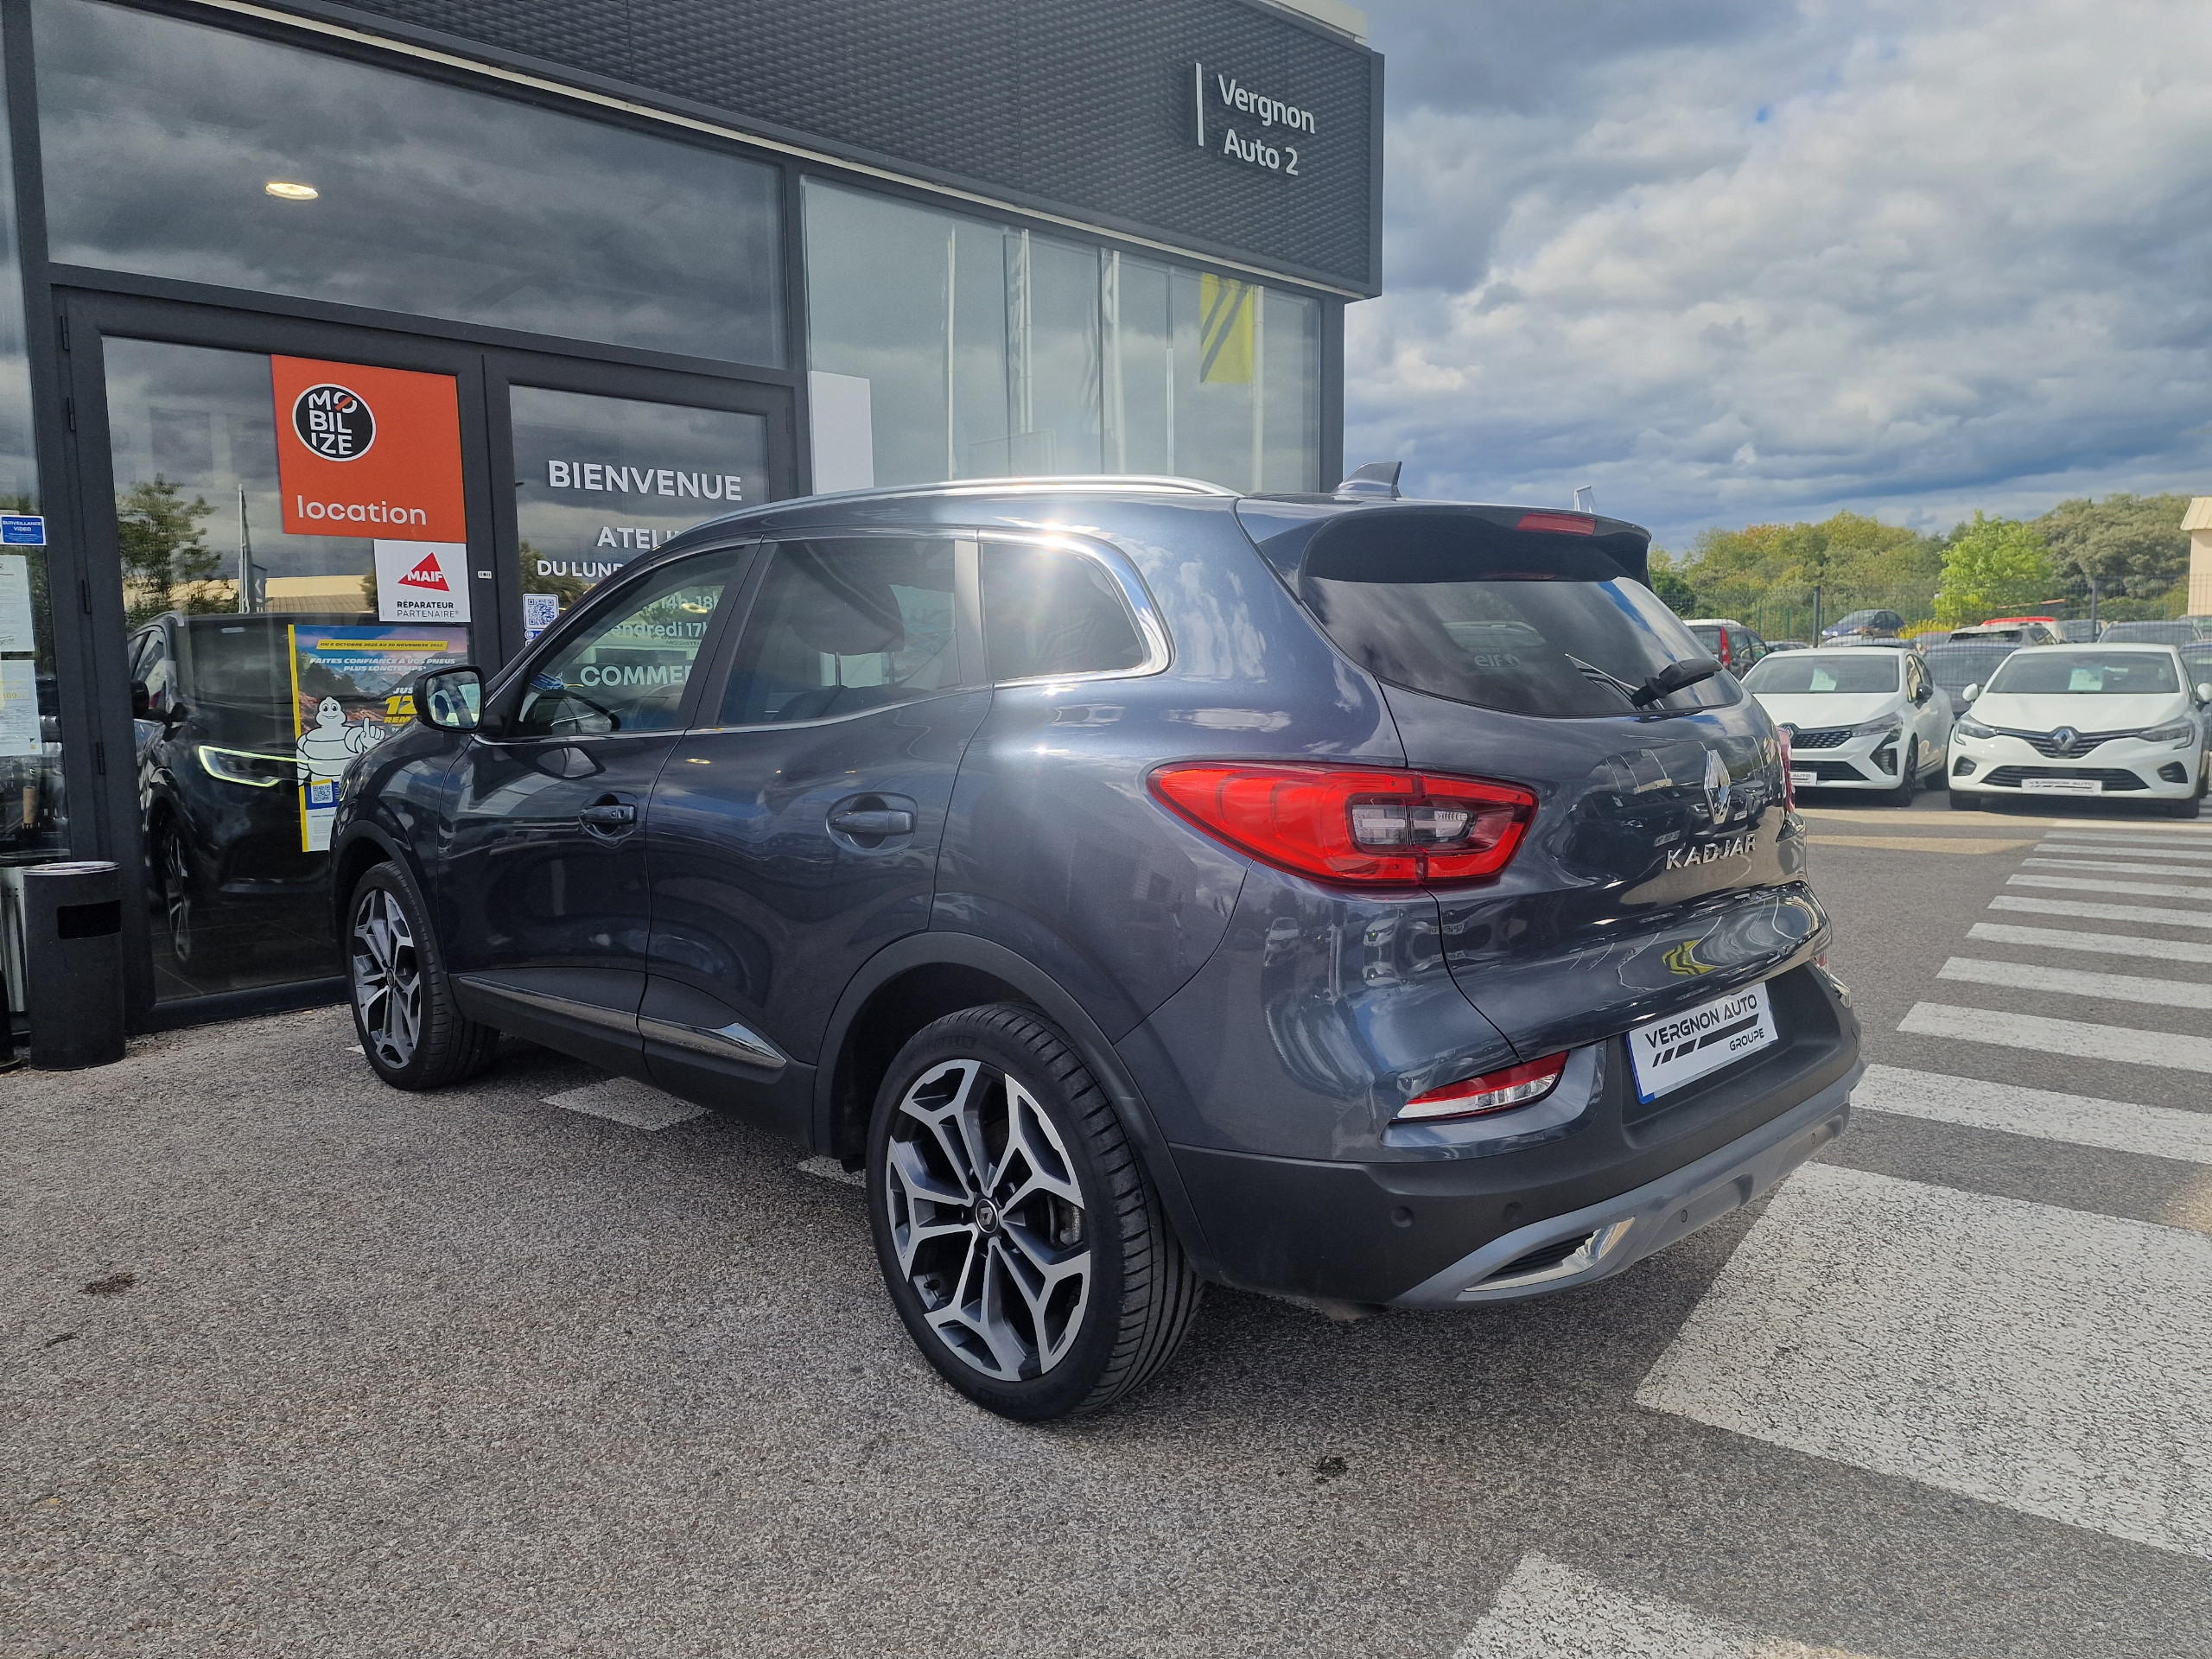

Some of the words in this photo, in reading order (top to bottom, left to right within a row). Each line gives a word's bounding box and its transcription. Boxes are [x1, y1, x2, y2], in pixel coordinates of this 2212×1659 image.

[1217, 74, 1316, 134] Vergnon
[1224, 128, 1280, 169] Auto
[1285, 147, 1299, 175] 2
[548, 460, 742, 501] BIENVENUE
[297, 494, 427, 525] location
[597, 526, 680, 550] ATEL
[407, 570, 443, 582] MAIF
[537, 559, 567, 577] DU
[397, 599, 454, 609] RÉPARATEUR
[1664, 833, 1758, 871] KADJAR
[1644, 1007, 1720, 1049] VERGNON
[1724, 994, 1758, 1021] AUTO
[1729, 1027, 1765, 1051] GROUPE
